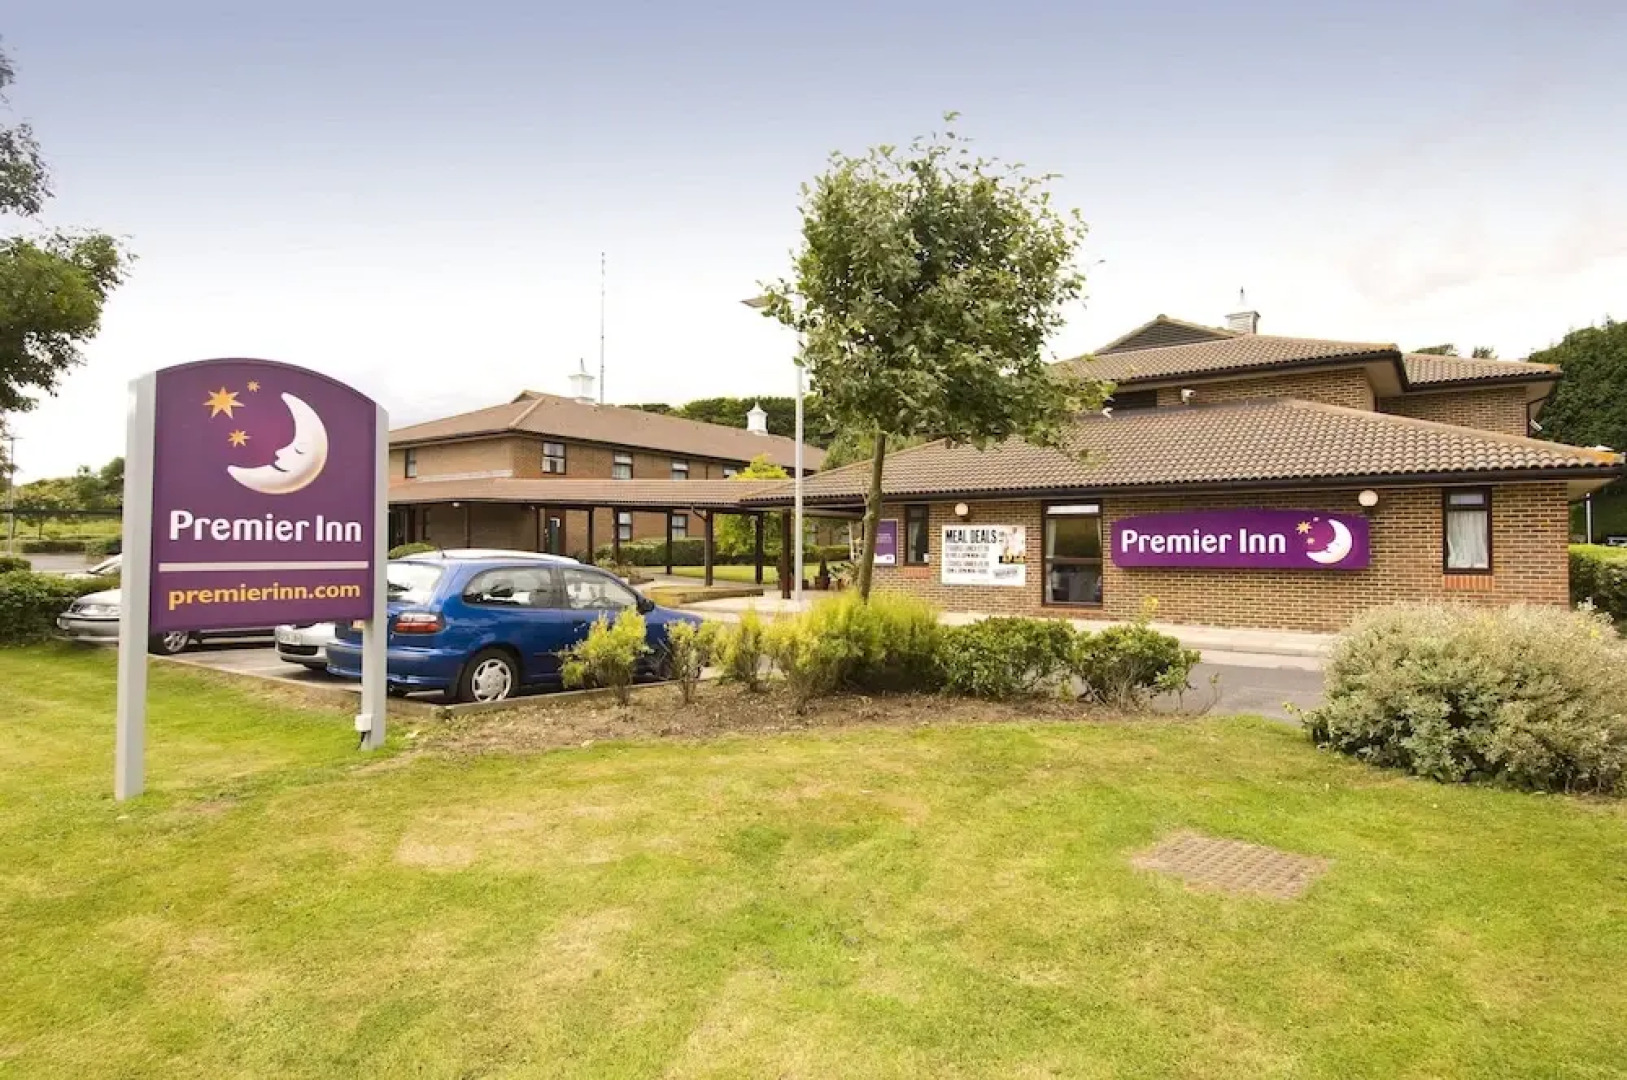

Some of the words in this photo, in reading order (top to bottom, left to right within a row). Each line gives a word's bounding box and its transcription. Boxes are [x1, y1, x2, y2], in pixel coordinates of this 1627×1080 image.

[169, 510, 310, 541] Premier
[315, 514, 362, 542] Inn
[945, 529, 968, 544] MEAL
[970, 529, 997, 544] DEALS
[1121, 528, 1233, 554] Premier
[1239, 528, 1287, 554] Inn
[168, 582, 361, 611] premierinn.com
